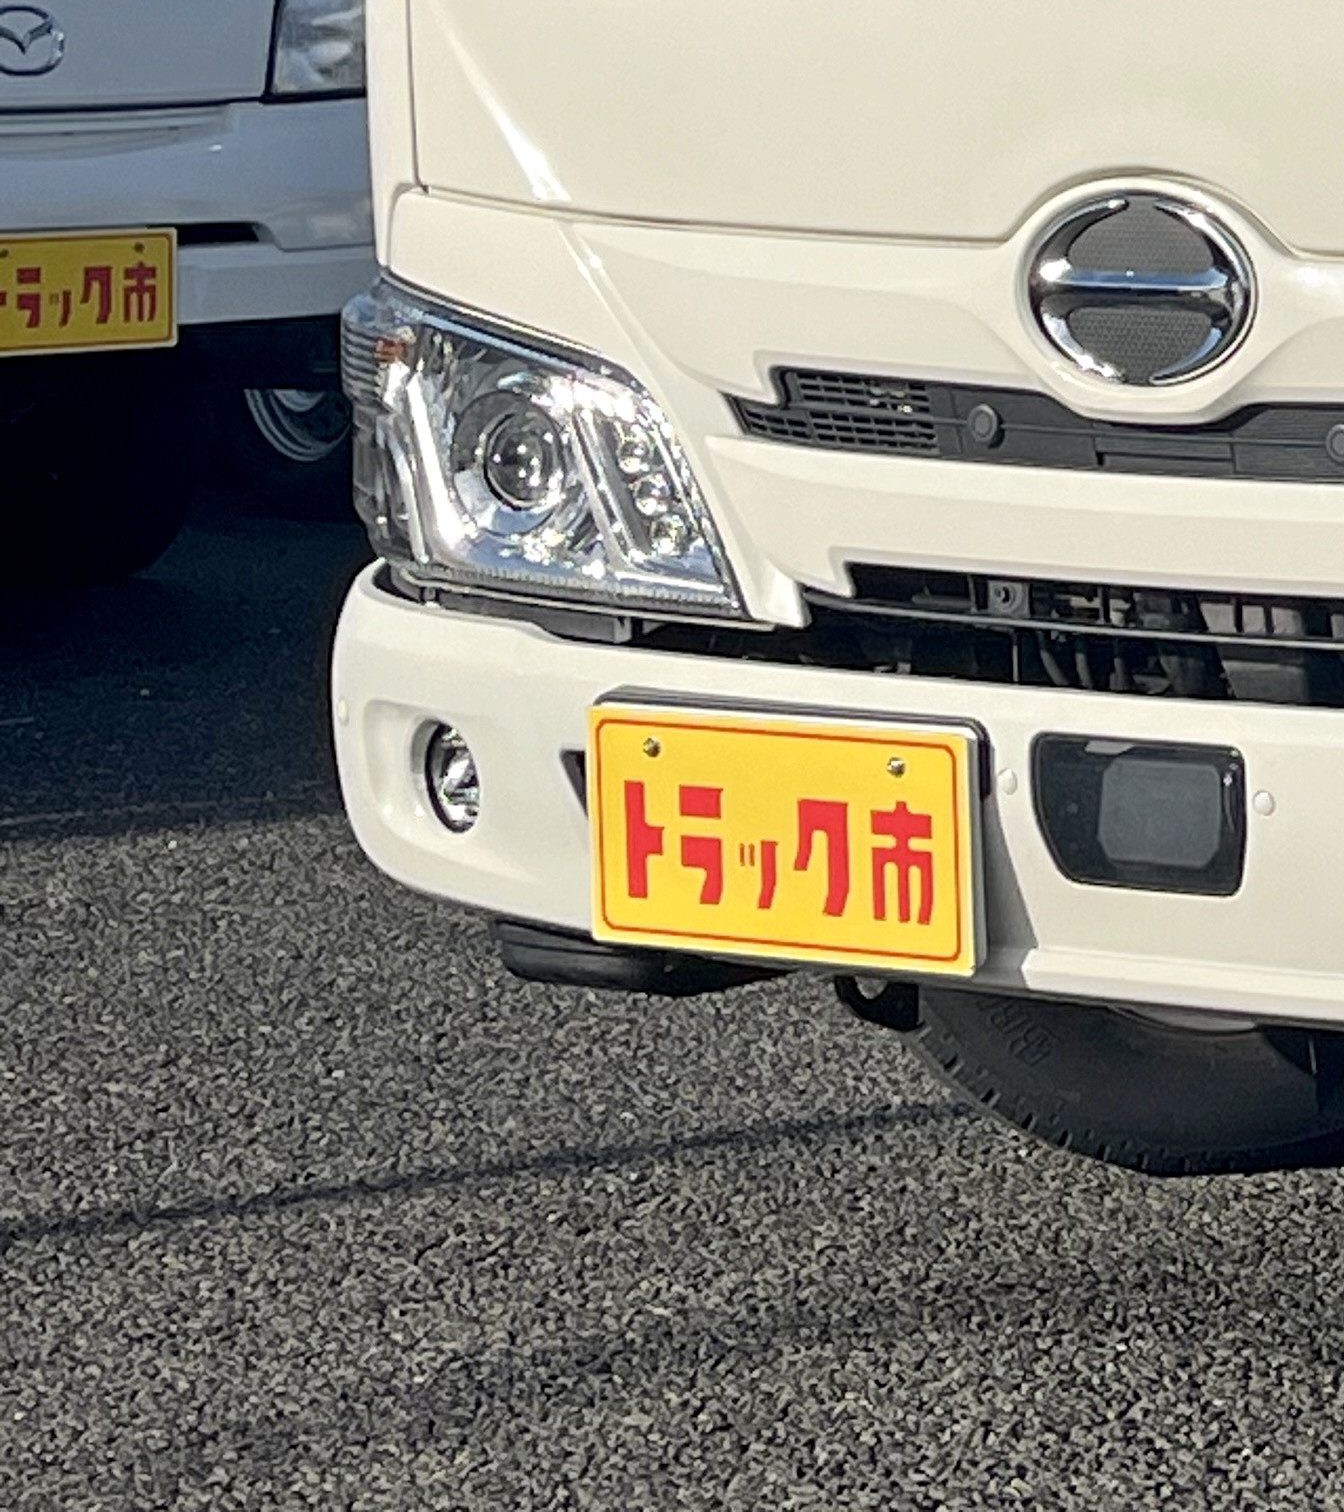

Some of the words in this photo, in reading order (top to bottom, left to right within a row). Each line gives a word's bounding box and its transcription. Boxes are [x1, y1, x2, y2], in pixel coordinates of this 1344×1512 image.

[0, 260, 158, 328] ラック市
[624, 779, 934, 925] トラック市
